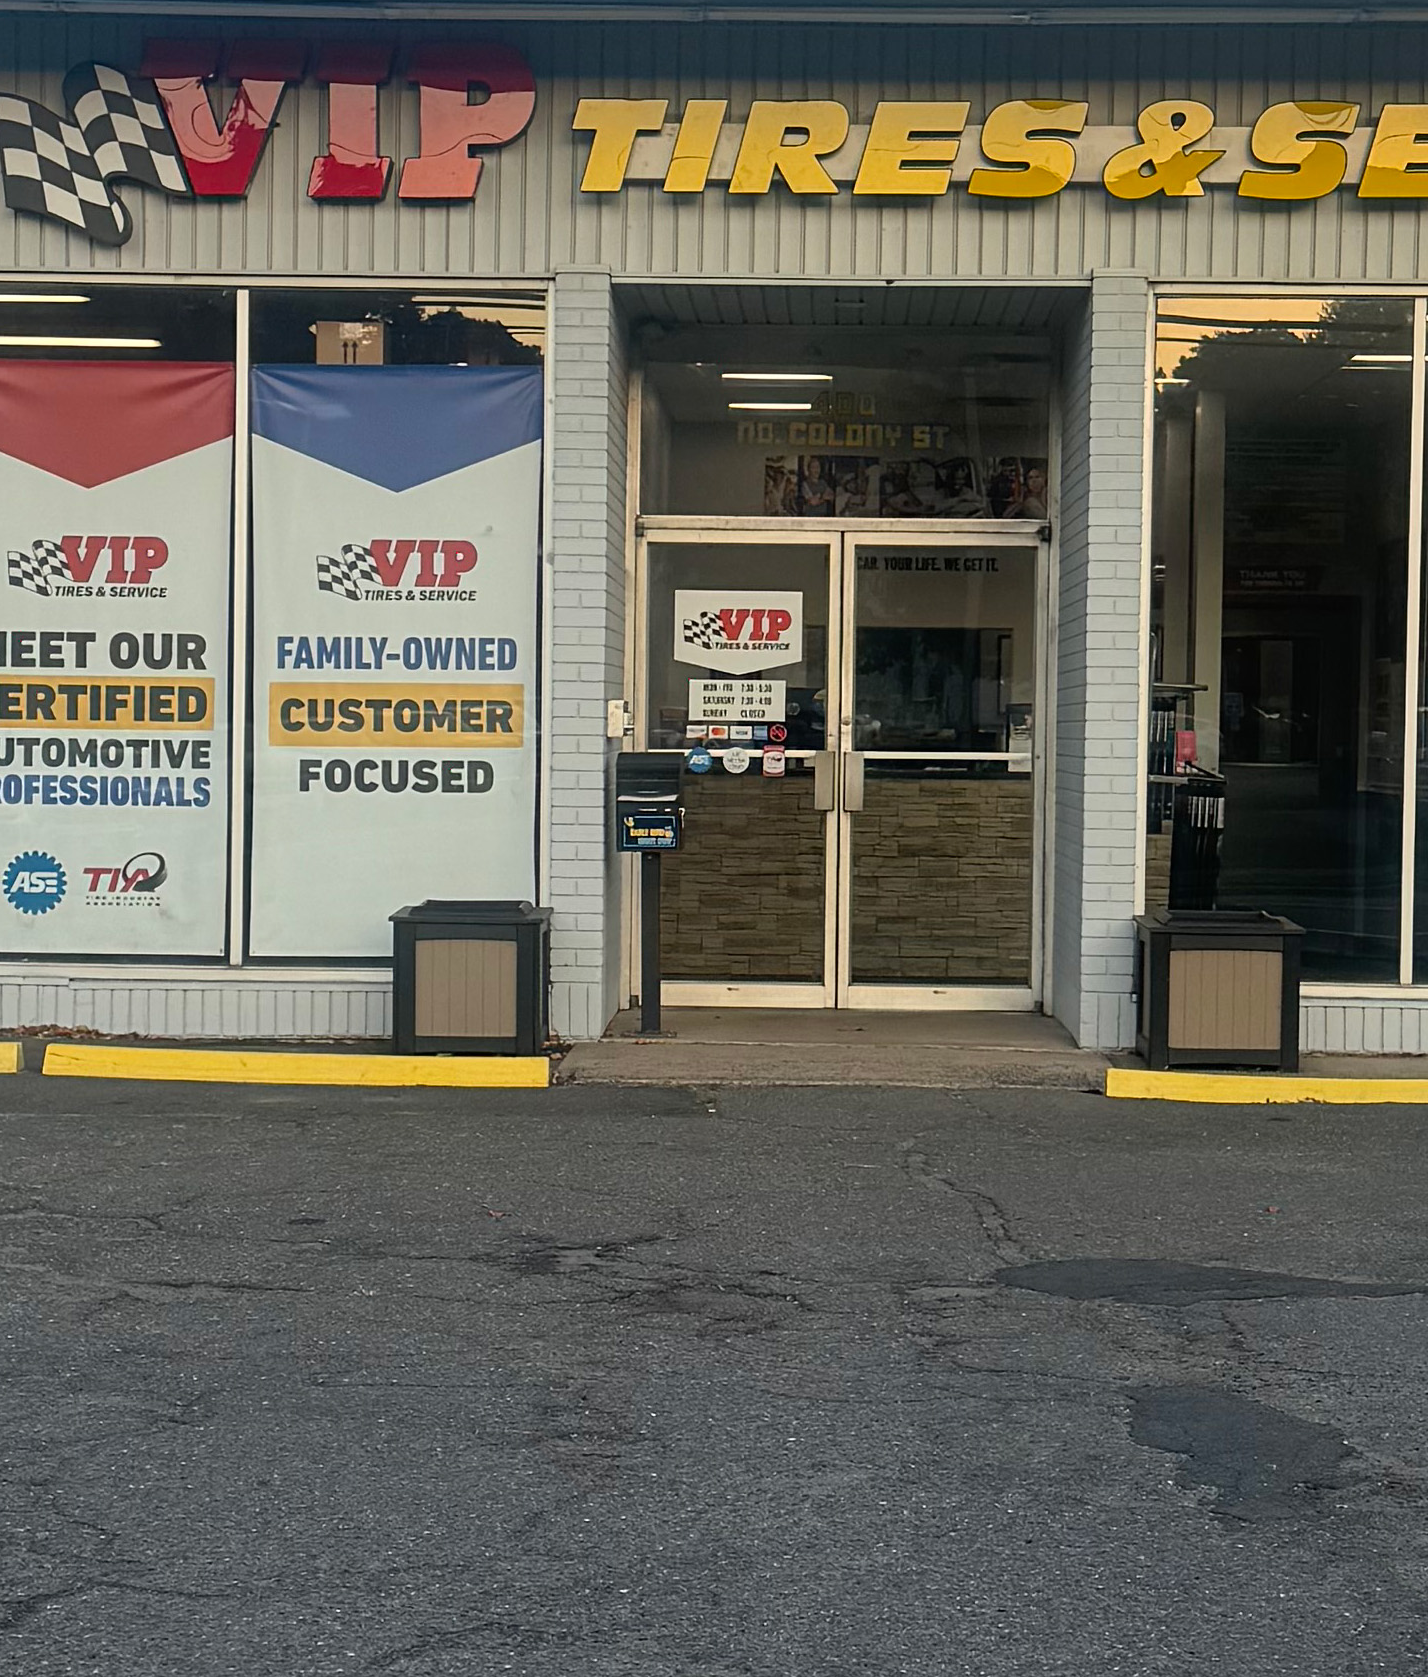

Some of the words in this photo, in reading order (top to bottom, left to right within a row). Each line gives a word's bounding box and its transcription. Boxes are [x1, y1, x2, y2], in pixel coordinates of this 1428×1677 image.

[139, 36, 538, 200] VIP
[572, 98, 1089, 198] TIRES
[1103, 100, 1227, 200] &
[788, 423, 902, 448] COLONY
[912, 425, 950, 450] ST
[60, 535, 168, 585] VIP
[370, 539, 478, 588] VIP
[884, 556, 912, 571] YOUR
[944, 557, 961, 572] WE
[963, 557, 983, 572] GET
[54, 585, 93, 597] TIRES
[95, 586, 107, 597] &
[109, 585, 168, 598] SERVICE
[364, 589, 403, 602] TIRES
[405, 590, 417, 602] &
[419, 590, 477, 602] SERVICE
[719, 609, 792, 641] VIP
[109, 632, 207, 671] OUR
[277, 636, 517, 672] FAMILY-OWNED
[715, 642, 740, 650] TIRES
[752, 642, 790, 650] SERVICE
[279, 698, 514, 735] CUSTOMER
[298, 759, 494, 794] FOCUSED
[10, 871, 58, 893] ASE
